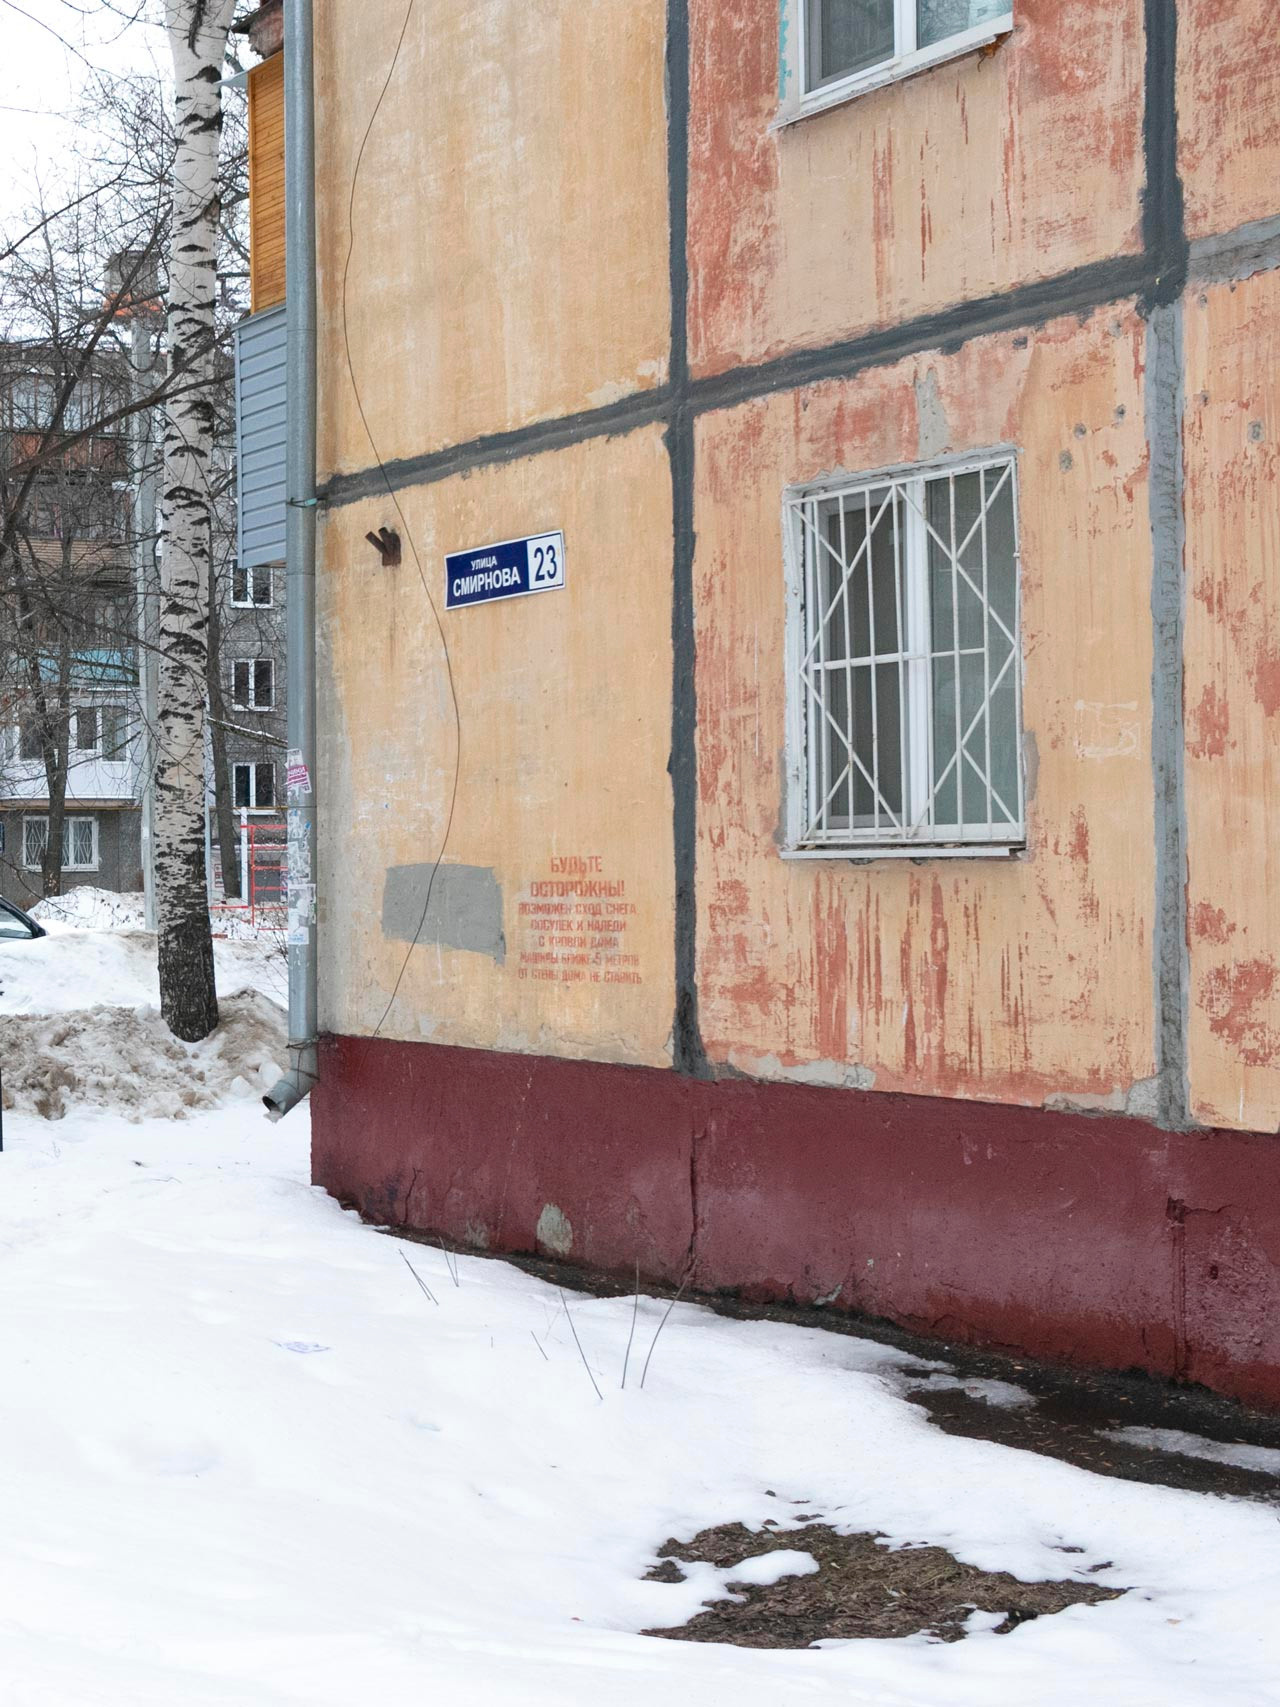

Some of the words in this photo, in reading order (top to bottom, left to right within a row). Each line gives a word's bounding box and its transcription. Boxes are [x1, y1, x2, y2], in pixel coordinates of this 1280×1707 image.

[453, 566, 521, 597] СМИРНОВА
[533, 544, 558, 583] 23
[470, 555, 498, 571] УЛИЦА
[551, 856, 602, 875] БУДЬТЕ
[530, 880, 625, 898] ОСТОРОЖНЫ!
[518, 902, 572, 916] ВОЗМОЖЕН
[575, 902, 602, 917] СХОД
[577, 921, 583, 930] И
[587, 920, 627, 932] НАЛЕДИ
[538, 936, 545, 947] С
[548, 936, 587, 948] КРОВЛИ
[590, 936, 619, 949] ДОМА
[605, 954, 640, 967] МЕТРОВ
[518, 969, 527, 979] ОТ
[531, 968, 559, 981] СТЕНЫ
[562, 969, 586, 982] ДОМА
[591, 971, 600, 982] НЕ
[604, 970, 642, 985] СТАВИТЬ
